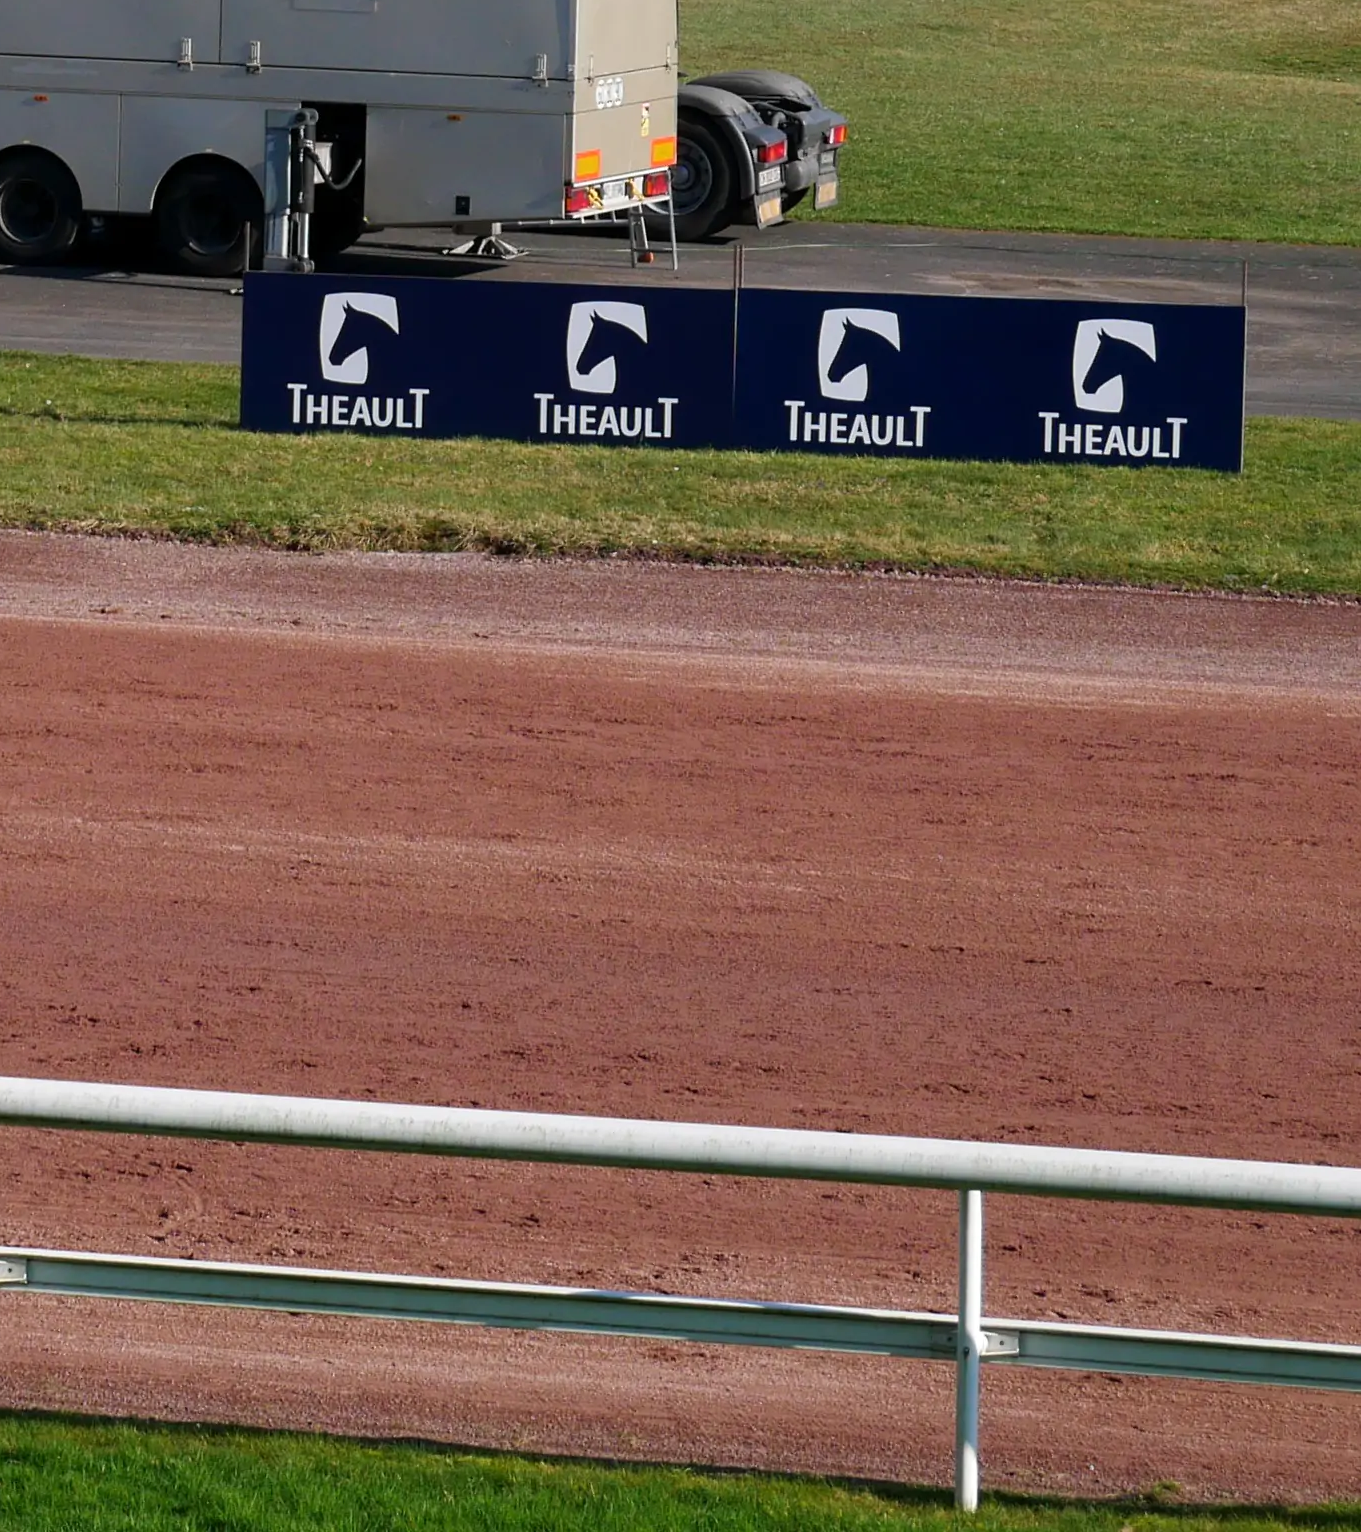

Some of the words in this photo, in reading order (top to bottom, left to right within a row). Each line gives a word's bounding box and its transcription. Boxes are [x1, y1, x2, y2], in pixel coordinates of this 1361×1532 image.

[287, 383, 430, 429] THEAULT
[534, 392, 679, 440] THEAULT
[784, 400, 931, 449] THEAULT
[1038, 411, 1188, 459] THEAULT
